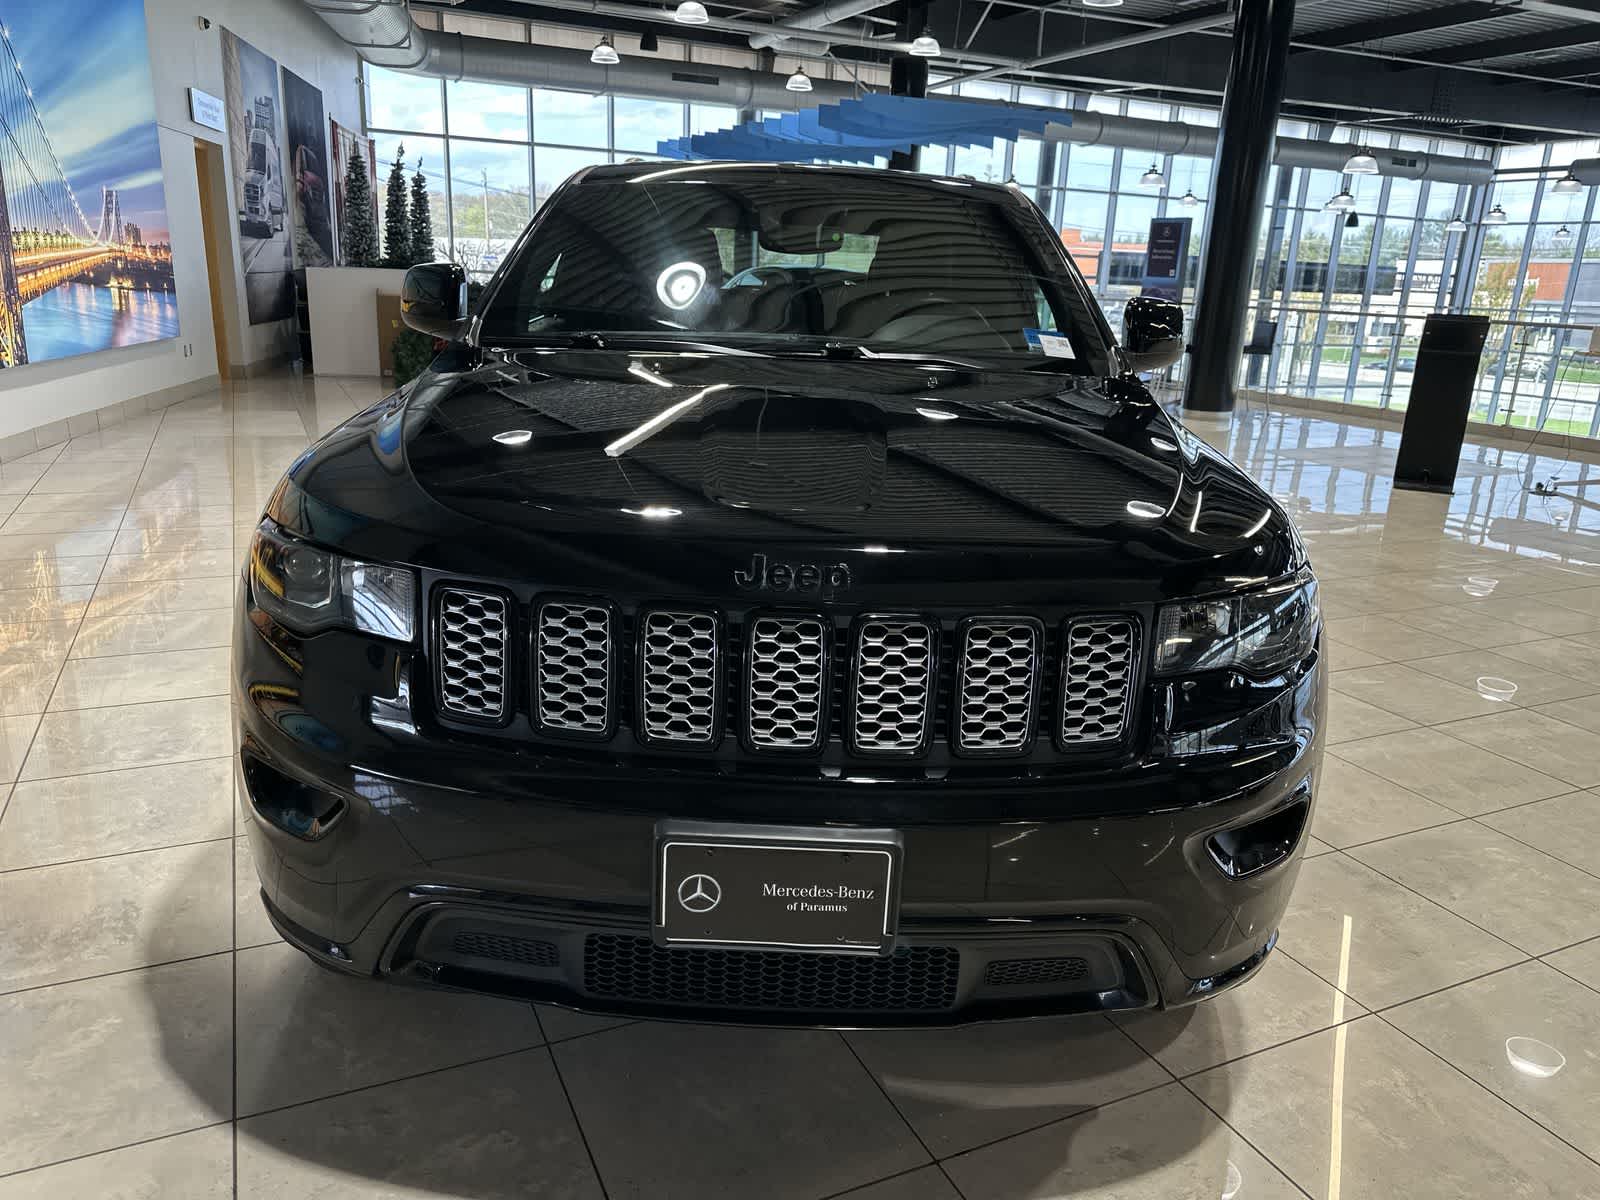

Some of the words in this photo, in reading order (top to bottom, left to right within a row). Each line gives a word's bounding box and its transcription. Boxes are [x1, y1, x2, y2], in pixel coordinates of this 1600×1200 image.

[734, 553, 851, 600] Jeep
[762, 883, 875, 900] Mercedes-Benz
[786, 902, 799, 911] of
[800, 902, 849, 912] Paramus
